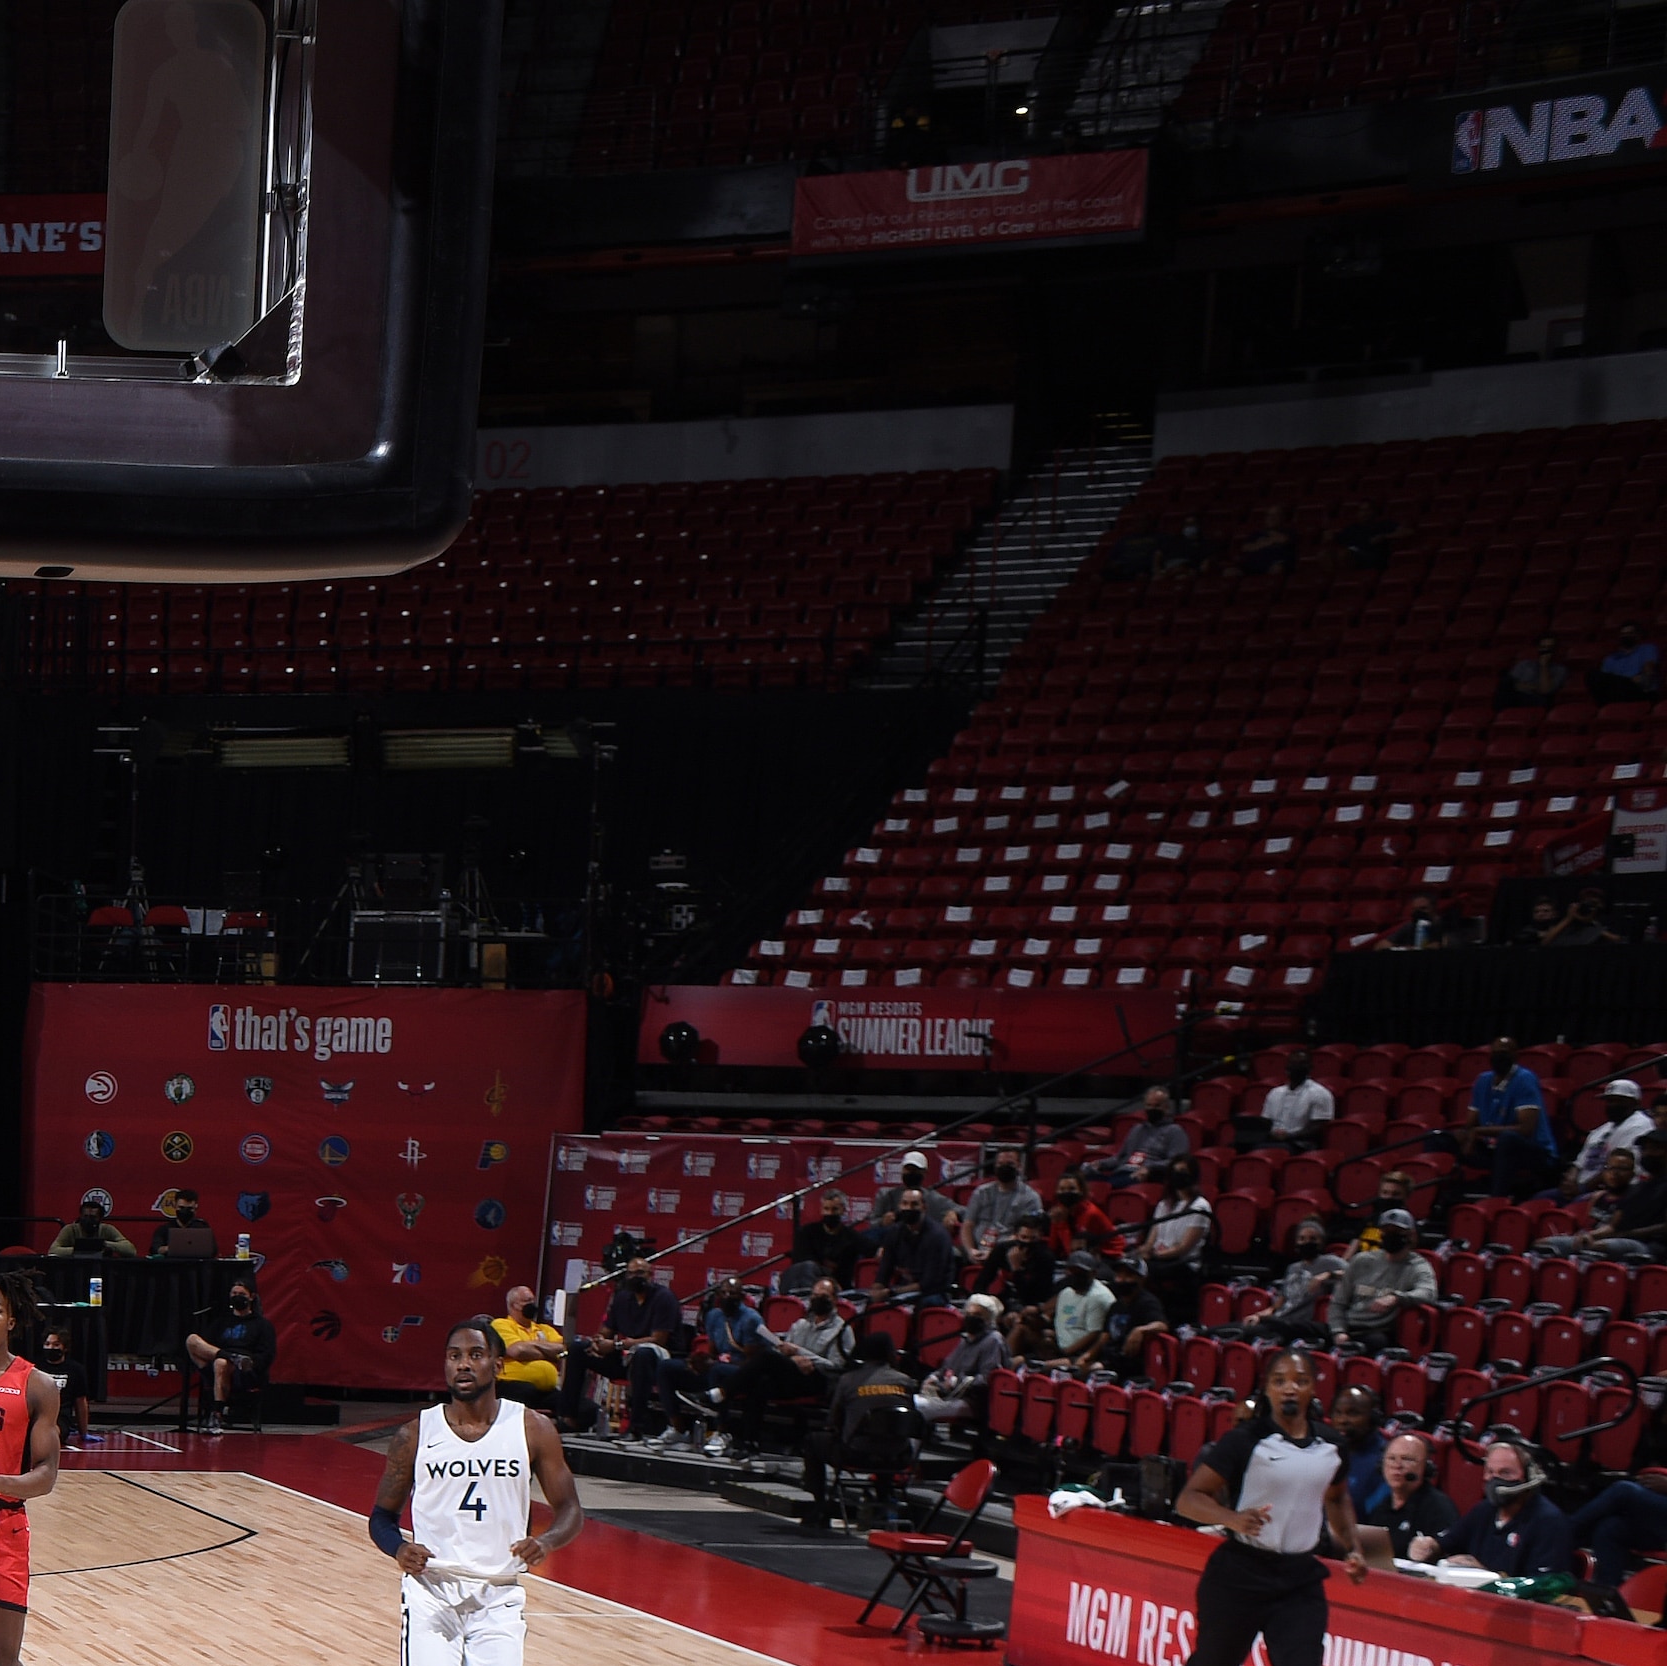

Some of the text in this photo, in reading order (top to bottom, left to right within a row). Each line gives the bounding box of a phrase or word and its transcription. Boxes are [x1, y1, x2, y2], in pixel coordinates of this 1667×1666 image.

[906, 159, 1030, 203] UMC
[871, 228, 932, 245] HIGHEST
[935, 225, 975, 241] LEVEL
[998, 220, 1035, 236] Care
[235, 1006, 394, 1061] that's game
[837, 1017, 922, 1056] SUMMER
[391, 1262, 422, 1285] 76
[426, 1457, 520, 1481] WOLVES
[458, 1481, 487, 1522] 4
[1067, 1581, 1133, 1660] MGM
